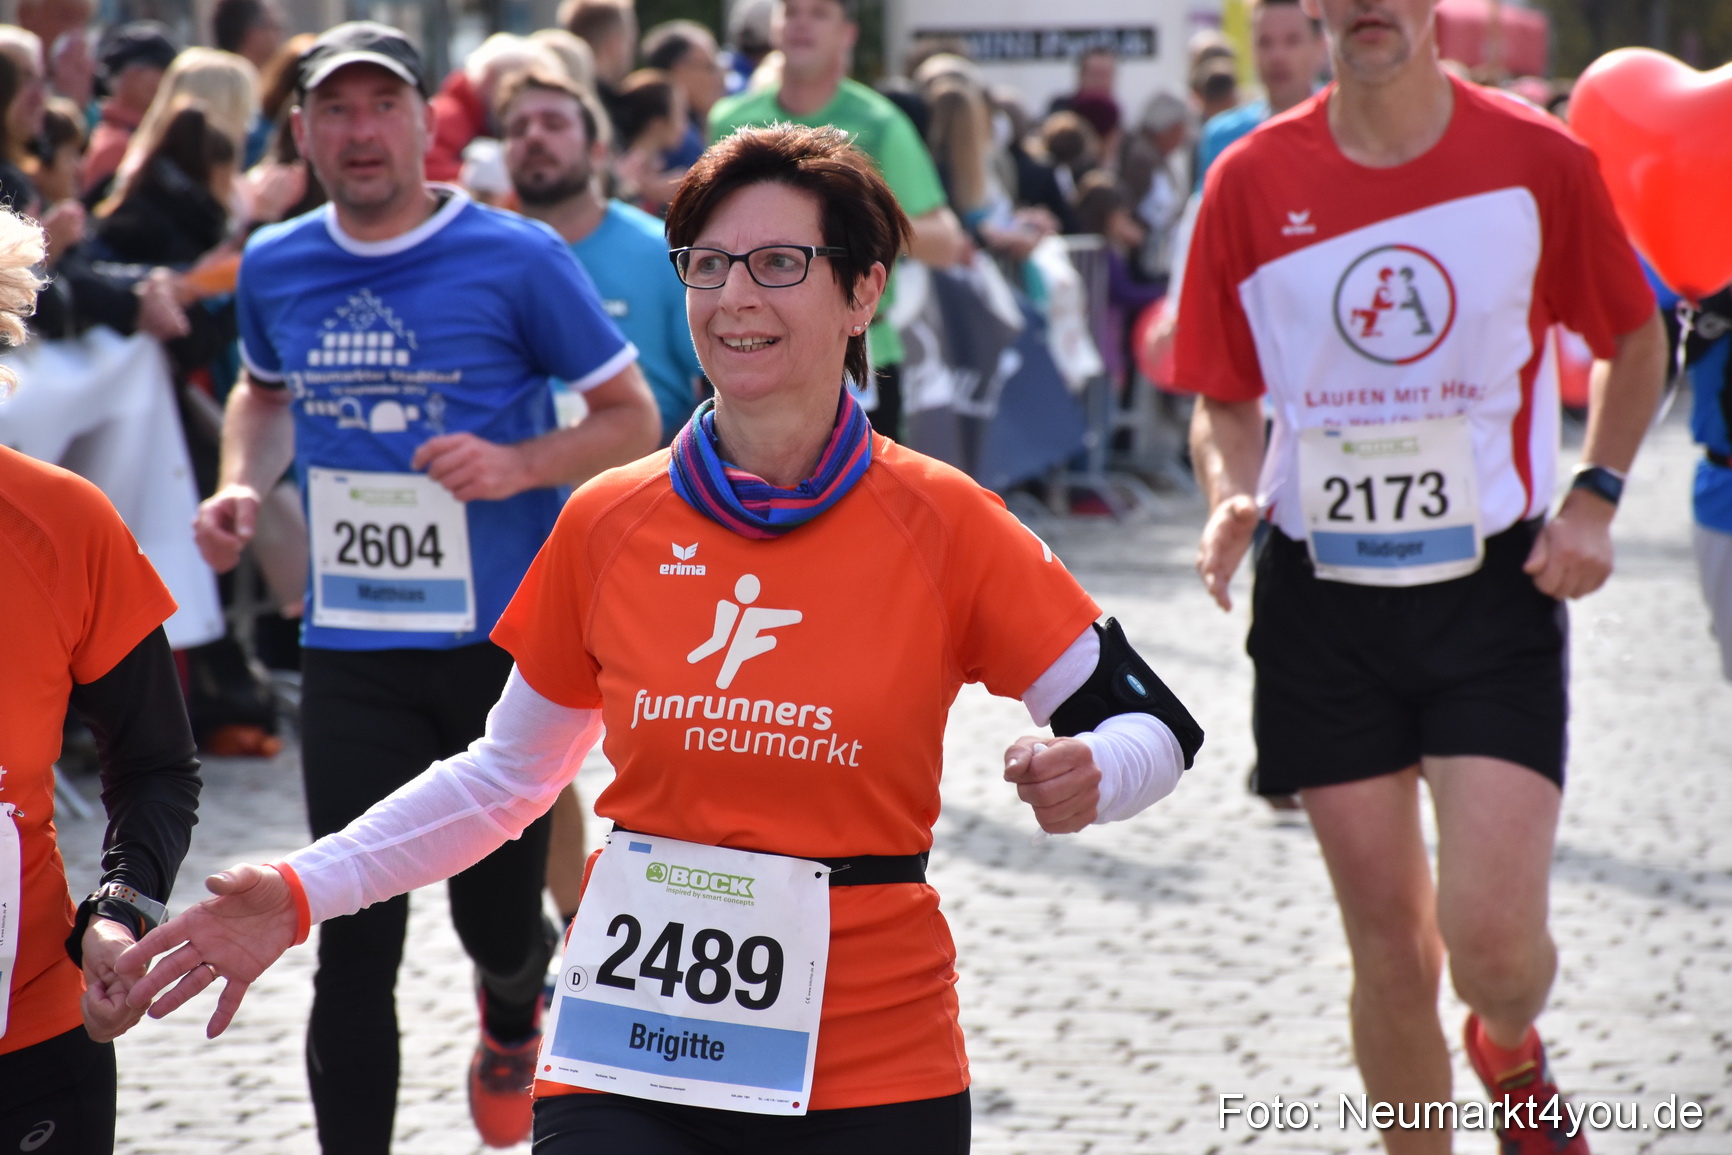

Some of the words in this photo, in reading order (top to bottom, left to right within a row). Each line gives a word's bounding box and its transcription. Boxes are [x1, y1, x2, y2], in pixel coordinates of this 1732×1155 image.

[1304, 388, 1386, 408] LAUFEN
[1395, 386, 1430, 404] MIT
[1323, 470, 1449, 523] 2173
[335, 520, 445, 569] 2604
[659, 562, 707, 576] erima
[631, 689, 834, 731] funrunners
[684, 726, 863, 767] neumarkt
[666, 886, 691, 897] inspired
[693, 889, 701, 899] by
[702, 893, 721, 901] smart
[723, 896, 755, 906] concepts
[668, 865, 754, 898] BOCK
[572, 972, 581, 985] D
[596, 913, 785, 1011] 2489
[628, 1022, 726, 1062] Brigitte
